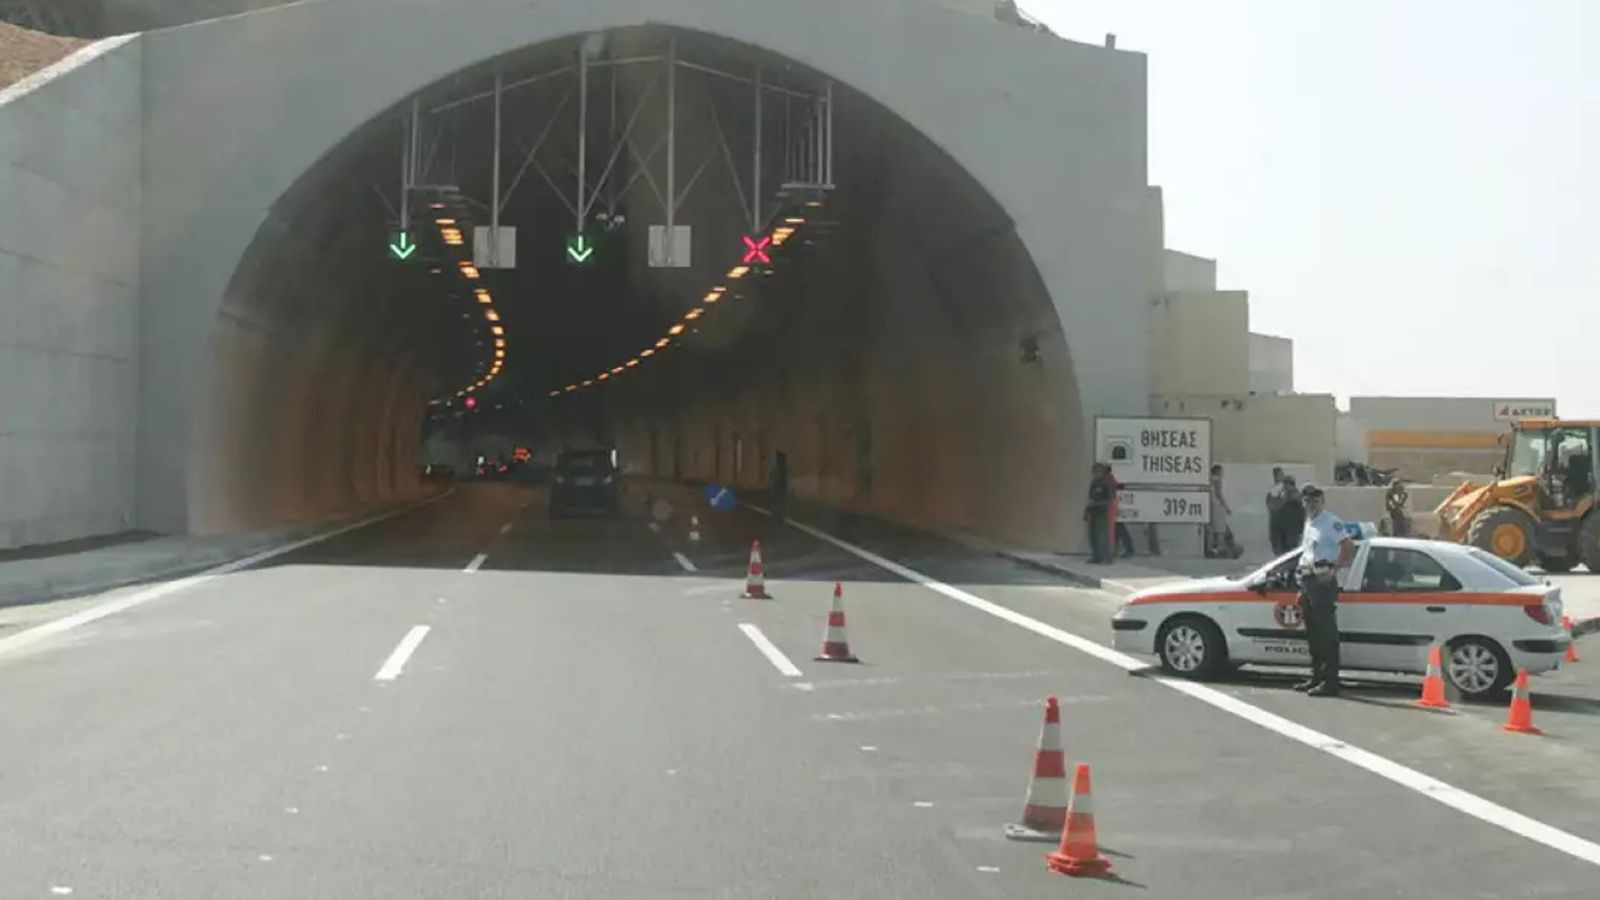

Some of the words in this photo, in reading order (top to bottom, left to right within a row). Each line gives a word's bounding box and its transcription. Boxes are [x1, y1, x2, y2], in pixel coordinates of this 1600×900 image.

[1141, 430, 1197, 448] ΘΗΣΕΑΣ
[1141, 455, 1202, 473] THISEAS
[1164, 498, 1187, 516] 319
[1188, 503, 1202, 516] m
